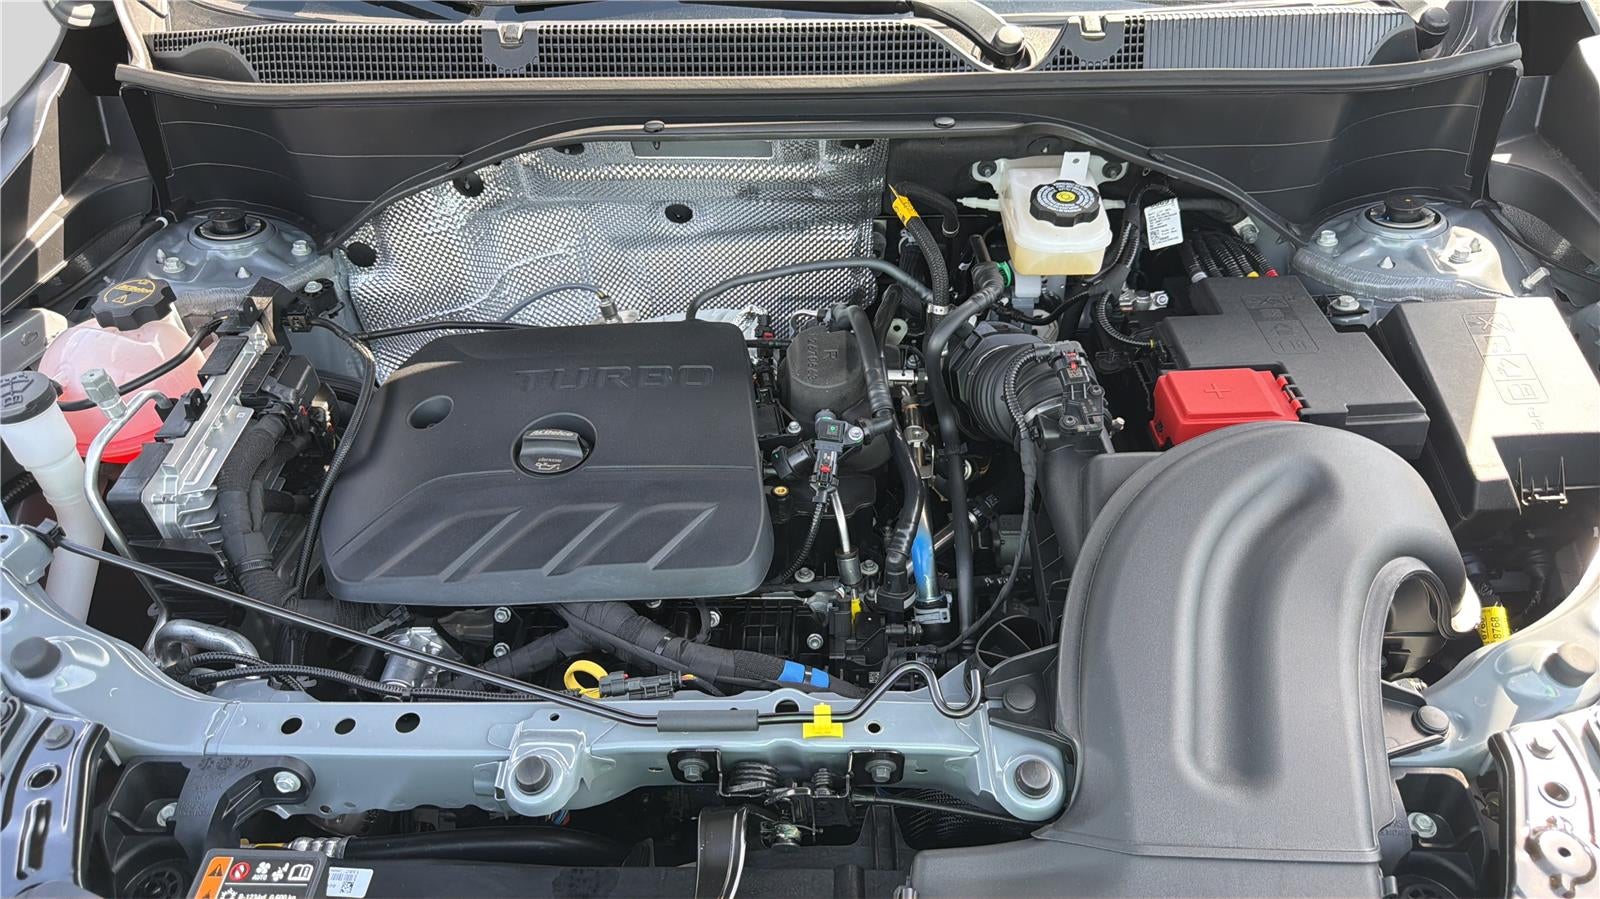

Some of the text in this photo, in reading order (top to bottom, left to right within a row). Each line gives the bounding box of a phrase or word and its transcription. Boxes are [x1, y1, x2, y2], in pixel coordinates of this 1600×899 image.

[512, 365, 714, 392] TURBO
[529, 429, 575, 437] ACDelco
[1491, 616, 1502, 640] 8768
